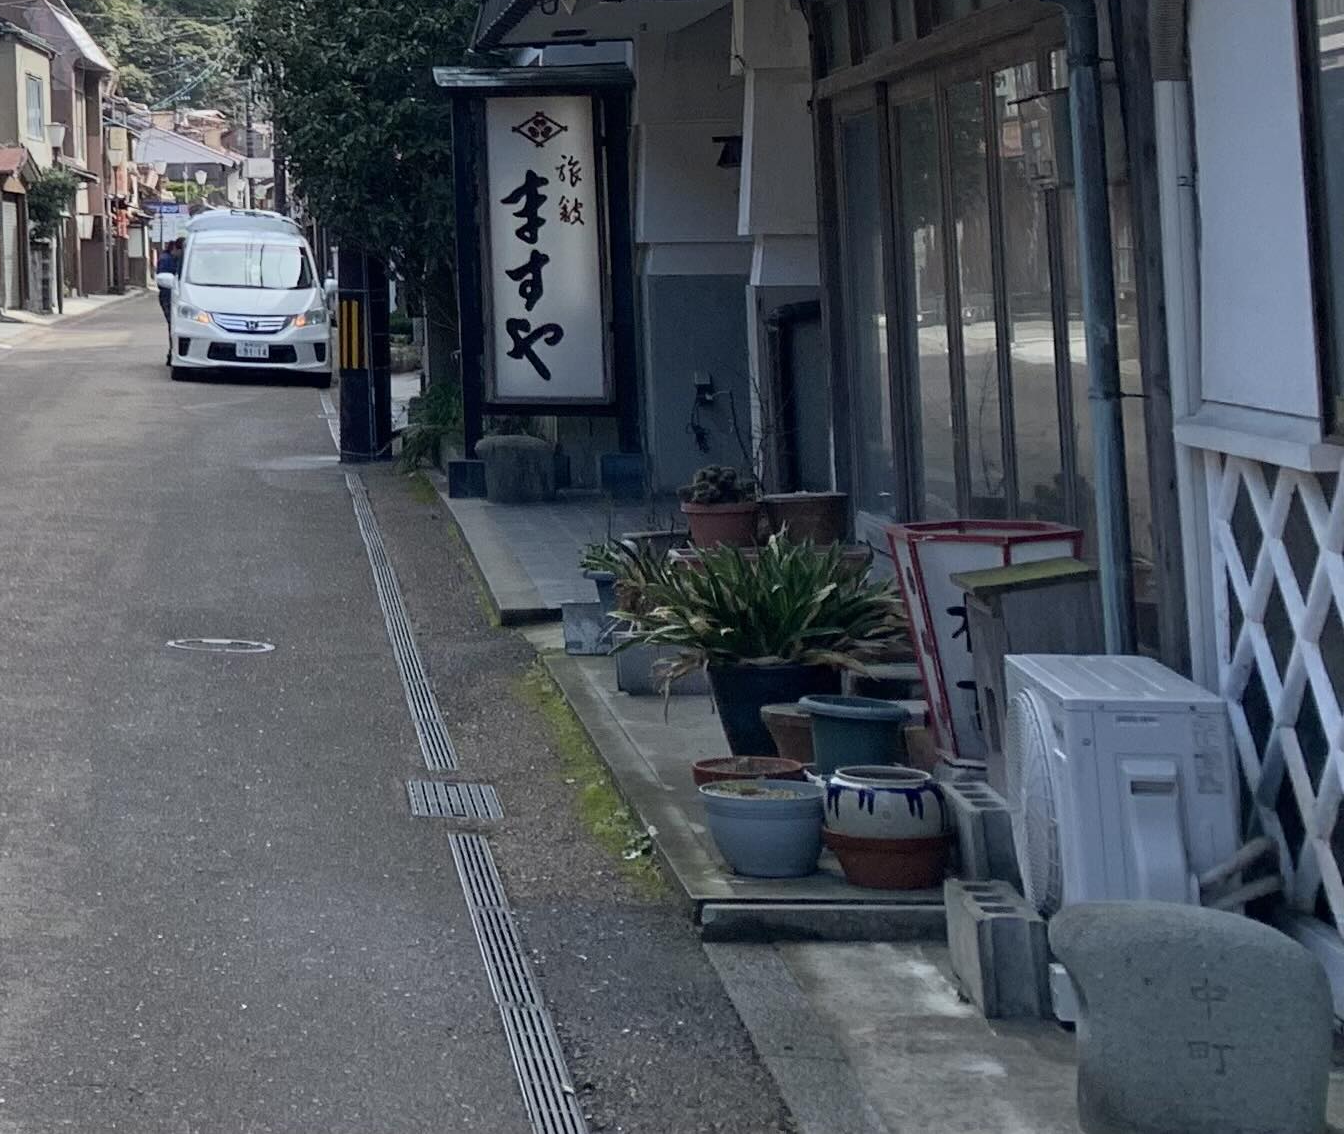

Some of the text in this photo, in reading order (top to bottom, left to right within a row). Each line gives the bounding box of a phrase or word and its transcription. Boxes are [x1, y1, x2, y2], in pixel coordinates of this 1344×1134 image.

[500, 169, 564, 381] ますや
[1188, 977, 1235, 1076] 中町
